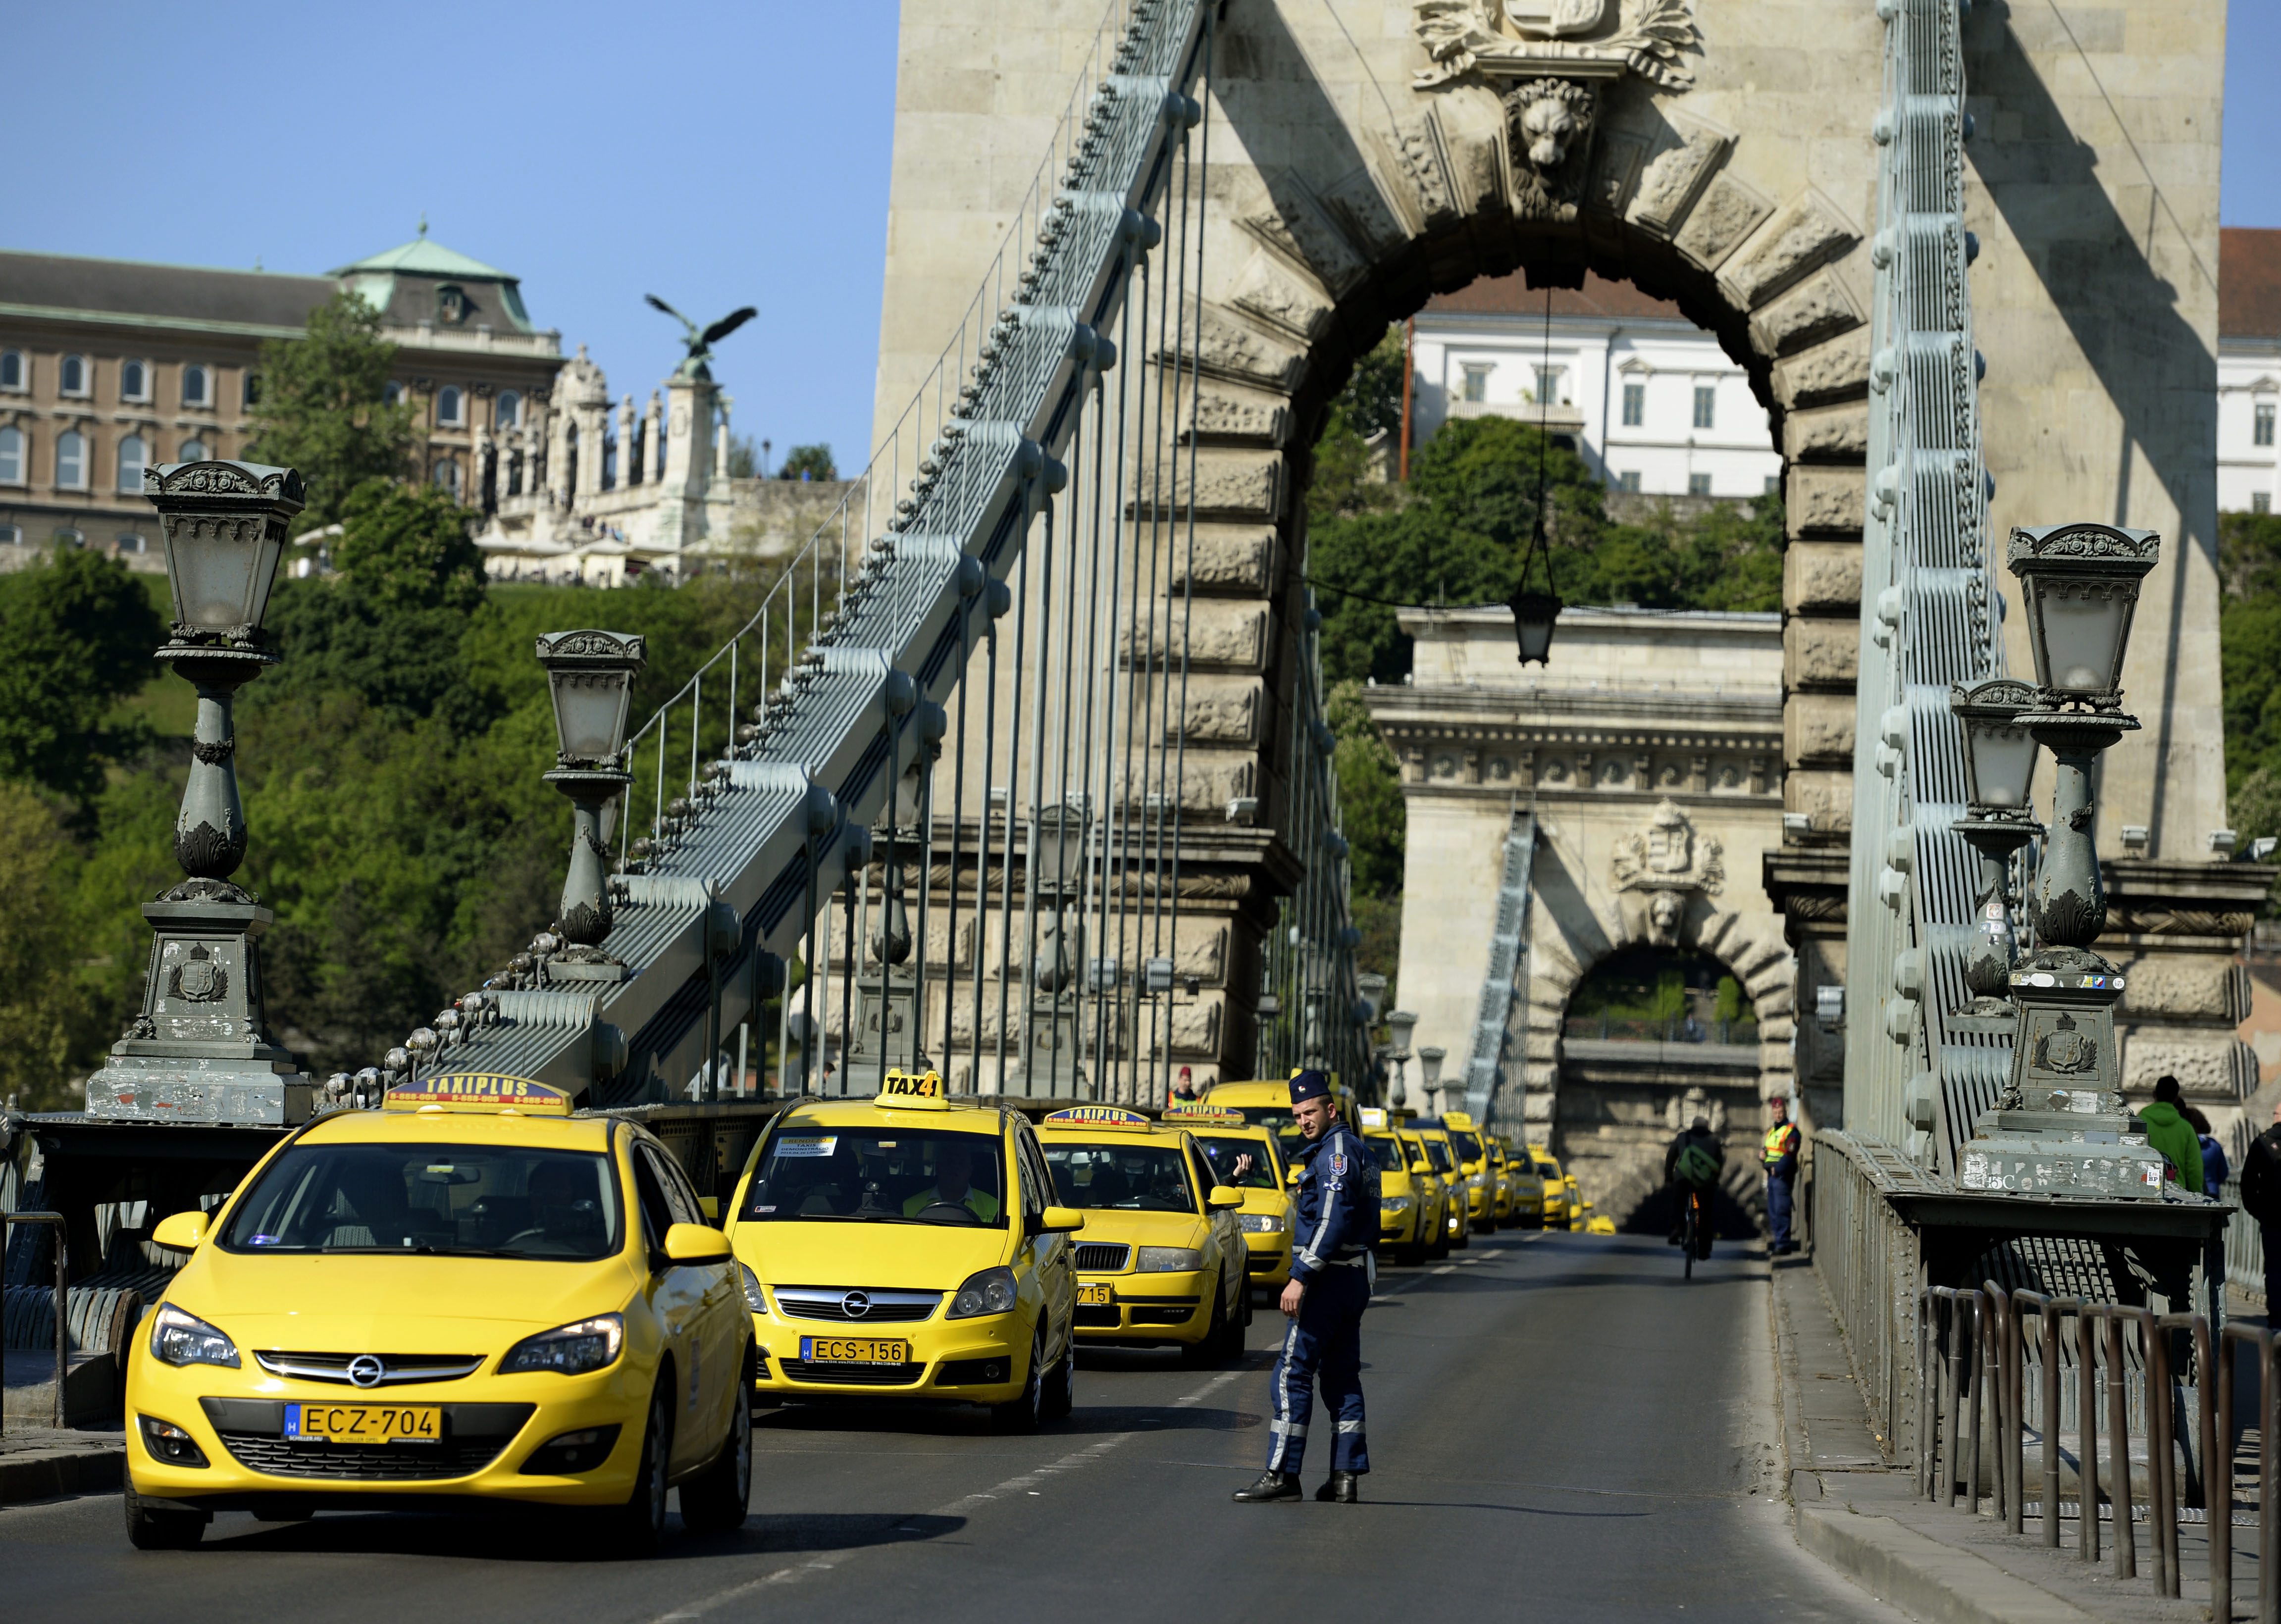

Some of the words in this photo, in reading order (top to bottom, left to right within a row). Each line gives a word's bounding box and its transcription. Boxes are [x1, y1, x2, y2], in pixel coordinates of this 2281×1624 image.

[426, 1076, 528, 1096] TAXIPLUS
[1068, 1109, 1127, 1121] TAXIPLUS
[816, 1340, 901, 1361] ECS-156
[288, 1422, 296, 1432] H
[306, 1409, 432, 1435] ECZ-704
